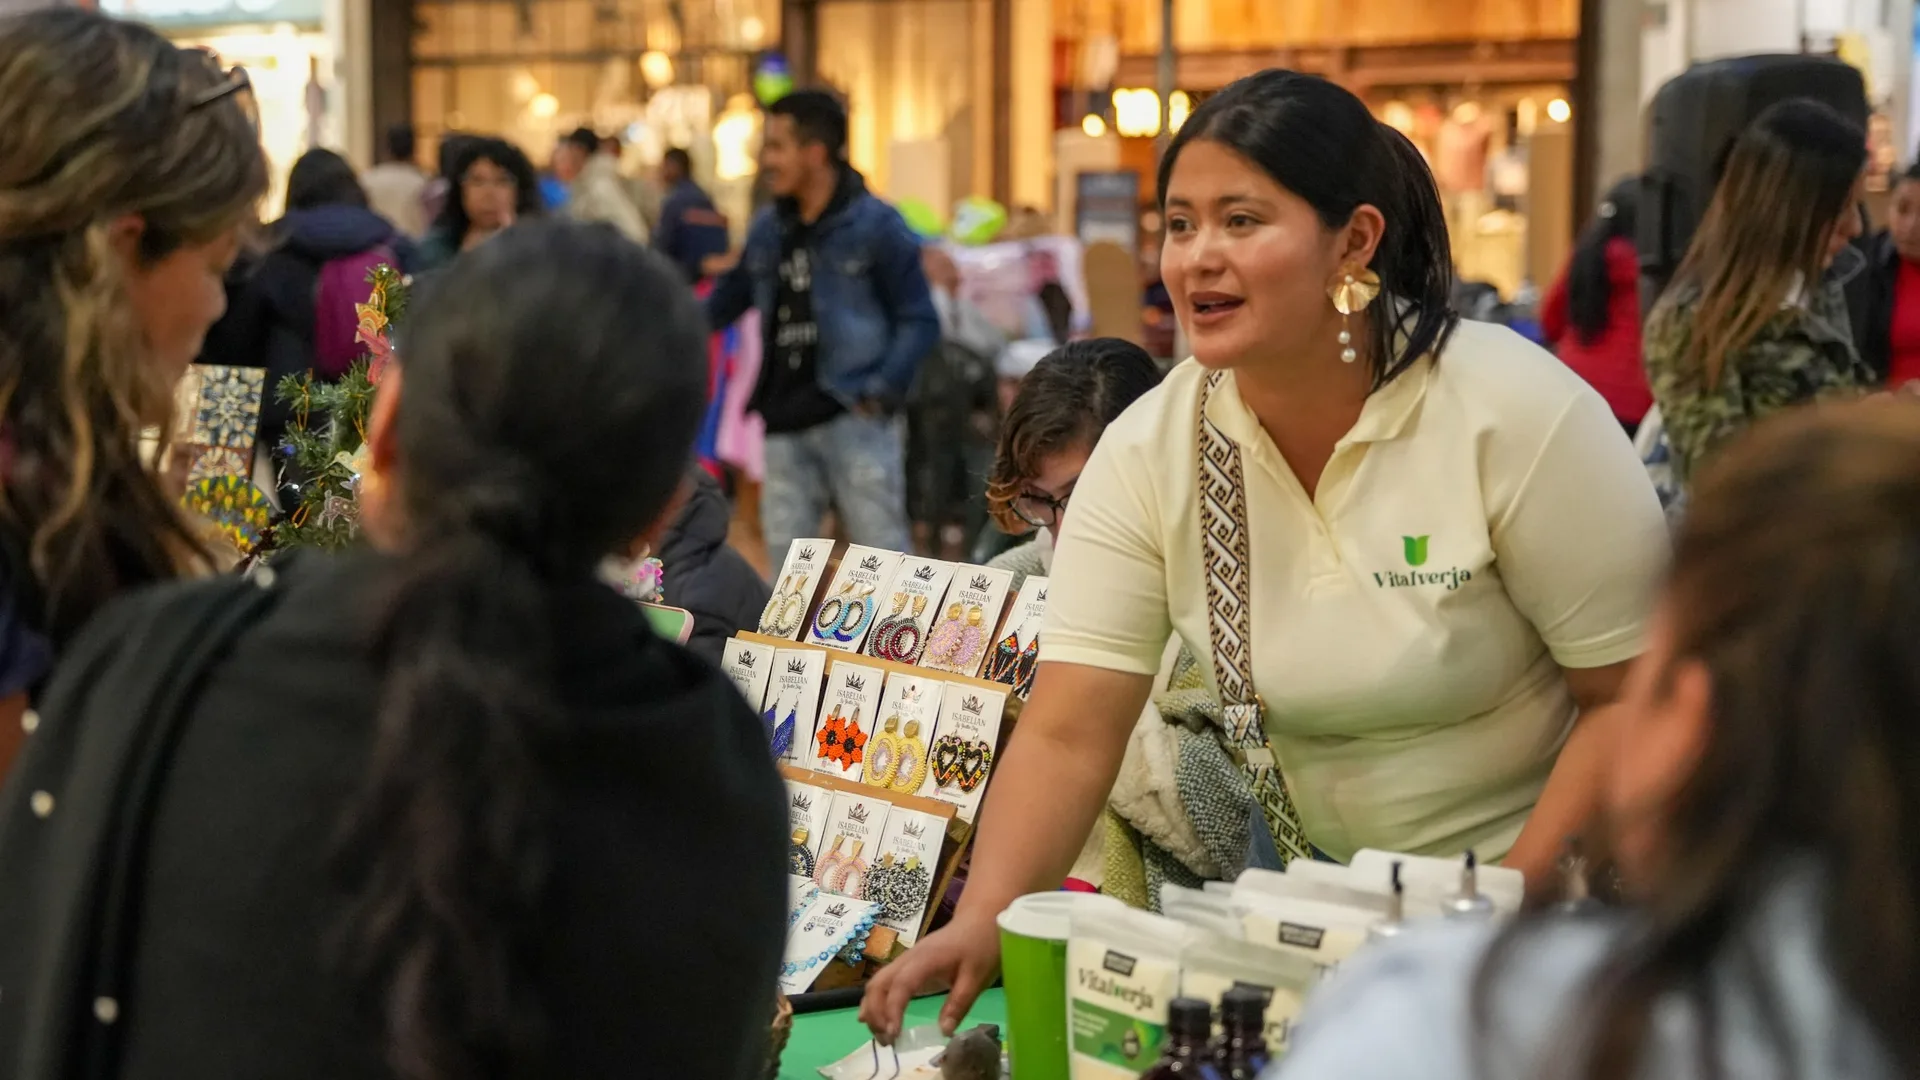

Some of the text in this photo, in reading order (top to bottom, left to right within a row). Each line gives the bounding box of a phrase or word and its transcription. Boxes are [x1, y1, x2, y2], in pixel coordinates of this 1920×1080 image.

[848, 569, 881, 581] ISABELIAN
[1373, 566, 1471, 590] Vitalverja
[959, 590, 992, 602] ISABELIAN
[779, 675, 808, 684] ISABELIAN
[836, 689, 867, 702] ISABELIAN
[952, 712, 986, 727] ISABELIAN
[838, 821, 870, 835] ISABELIAN
